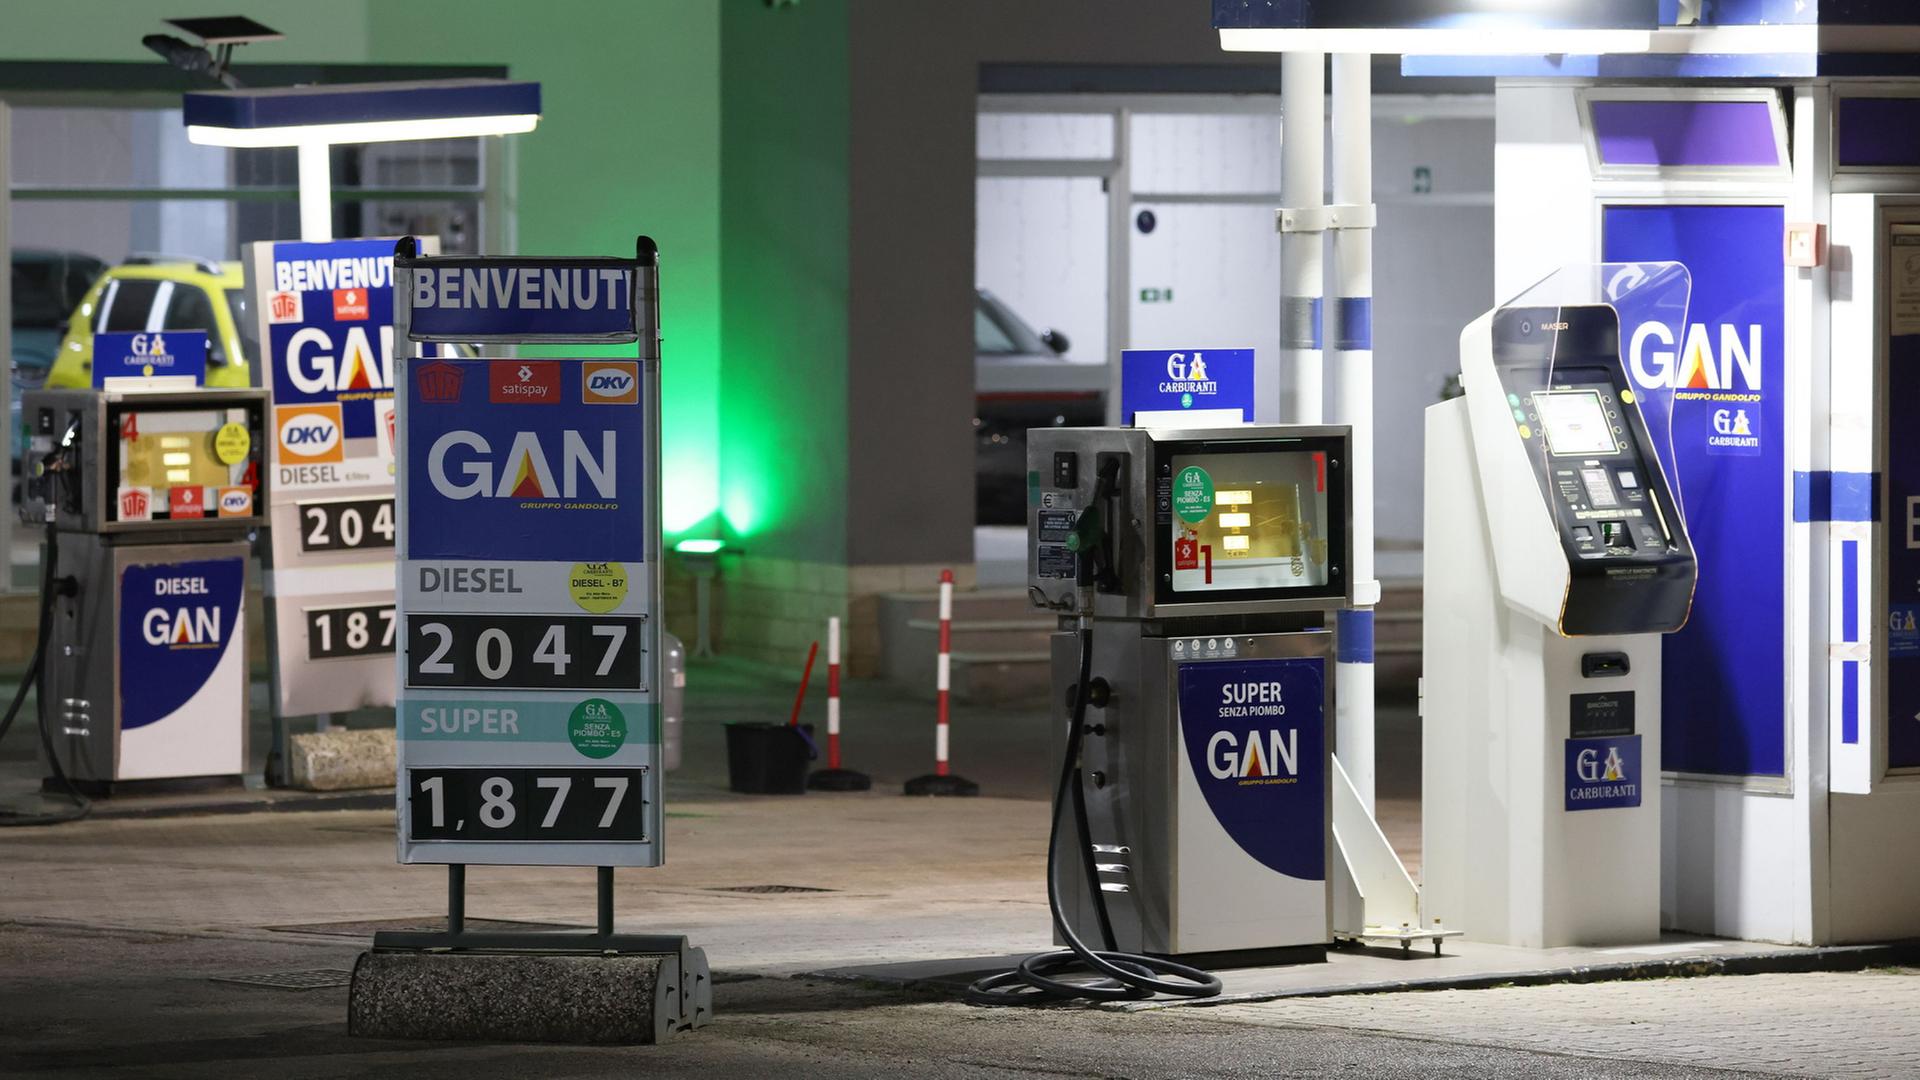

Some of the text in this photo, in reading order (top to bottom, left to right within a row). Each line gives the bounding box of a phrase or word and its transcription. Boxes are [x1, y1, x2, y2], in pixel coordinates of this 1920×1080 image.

[1541, 322, 1569, 331] MASER
[131, 333, 167, 356] GA
[1629, 320, 1762, 391] GAN
[1167, 352, 1209, 382] GA
[502, 383, 548, 397] satispay
[590, 376, 631, 390] DKV
[1159, 381, 1217, 394] CARBURANTI
[1675, 392, 1761, 402] GRUPPO GANDOLFO
[120, 412, 139, 443] 4
[1713, 409, 1752, 435] GA
[286, 425, 333, 445] DKV
[1709, 436, 1758, 447] CARBURANTI
[280, 465, 340, 486] DIESEL
[427, 430, 617, 500] GAN
[1312, 451, 1325, 493] 1
[1200, 544, 1212, 584] 1
[155, 576, 209, 596] DIESEL
[420, 567, 523, 594] DIESEL
[572, 578, 605, 588] DIESEL
[612, 578, 624, 588] B7
[143, 606, 221, 646] GAN
[1222, 681, 1282, 704] SUPER
[420, 706, 519, 735] SUPER
[585, 703, 607, 716] GA
[1218, 704, 1286, 718] SENZA PIOMBO
[573, 729, 605, 737] PIOMBO
[611, 729, 622, 738] E5
[584, 722, 611, 731] SENZA
[1207, 728, 1298, 780] GAN
[1577, 746, 1627, 783] GA
[1570, 784, 1636, 800] CARBURANTI
[420, 776, 629, 832] 1,877
